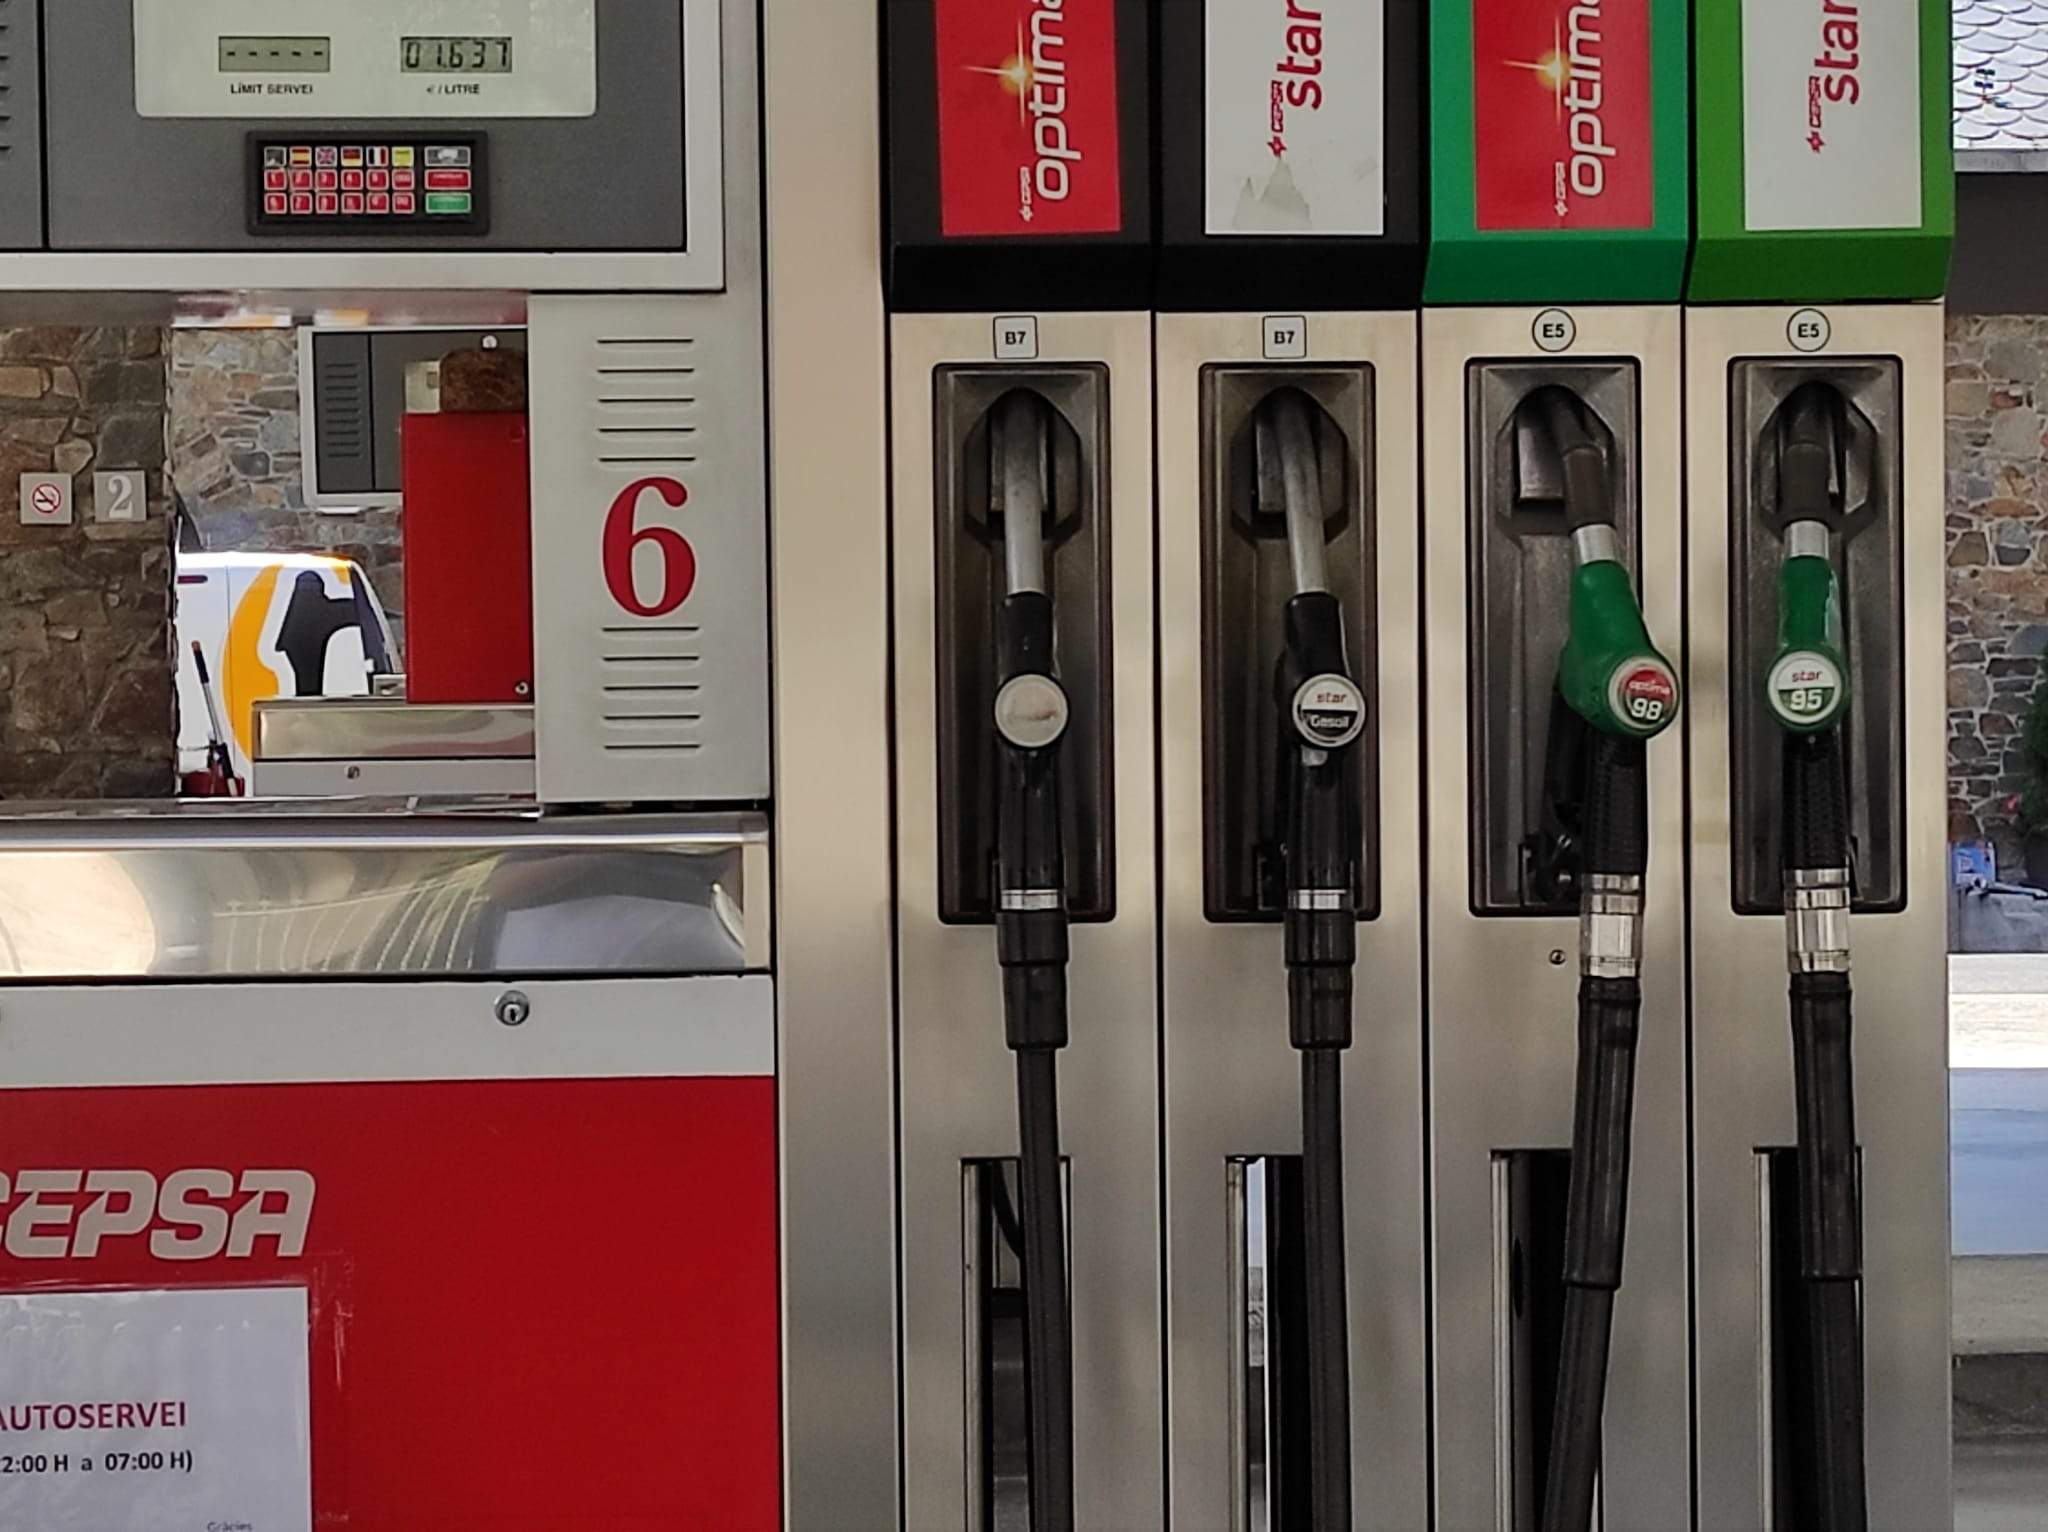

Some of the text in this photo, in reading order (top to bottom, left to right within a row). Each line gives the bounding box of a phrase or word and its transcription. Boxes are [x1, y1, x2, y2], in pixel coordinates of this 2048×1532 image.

[405, 41, 508, 69] 01.637
[1277, 0, 1322, 110] star
[1028, 0, 1081, 200] optim
[1563, 0, 1616, 196] optim
[1005, 331, 1026, 345] B7
[1274, 331, 1295, 344] B7
[1543, 323, 1565, 338] E5
[1798, 323, 1820, 338] E5
[108, 475, 133, 519] 2
[602, 476, 697, 617] 6
[1792, 670, 1822, 683] star
[1316, 692, 1347, 703] star
[1631, 697, 1662, 720] 98
[1790, 689, 1823, 711] 95
[0, 1169, 316, 1260] EPSA
[54, 1454, 68, 1472] H
[81, 1458, 93, 1471] a
[105, 1452, 164, 1471] 07:00
[170, 1450, 193, 1472] H)
